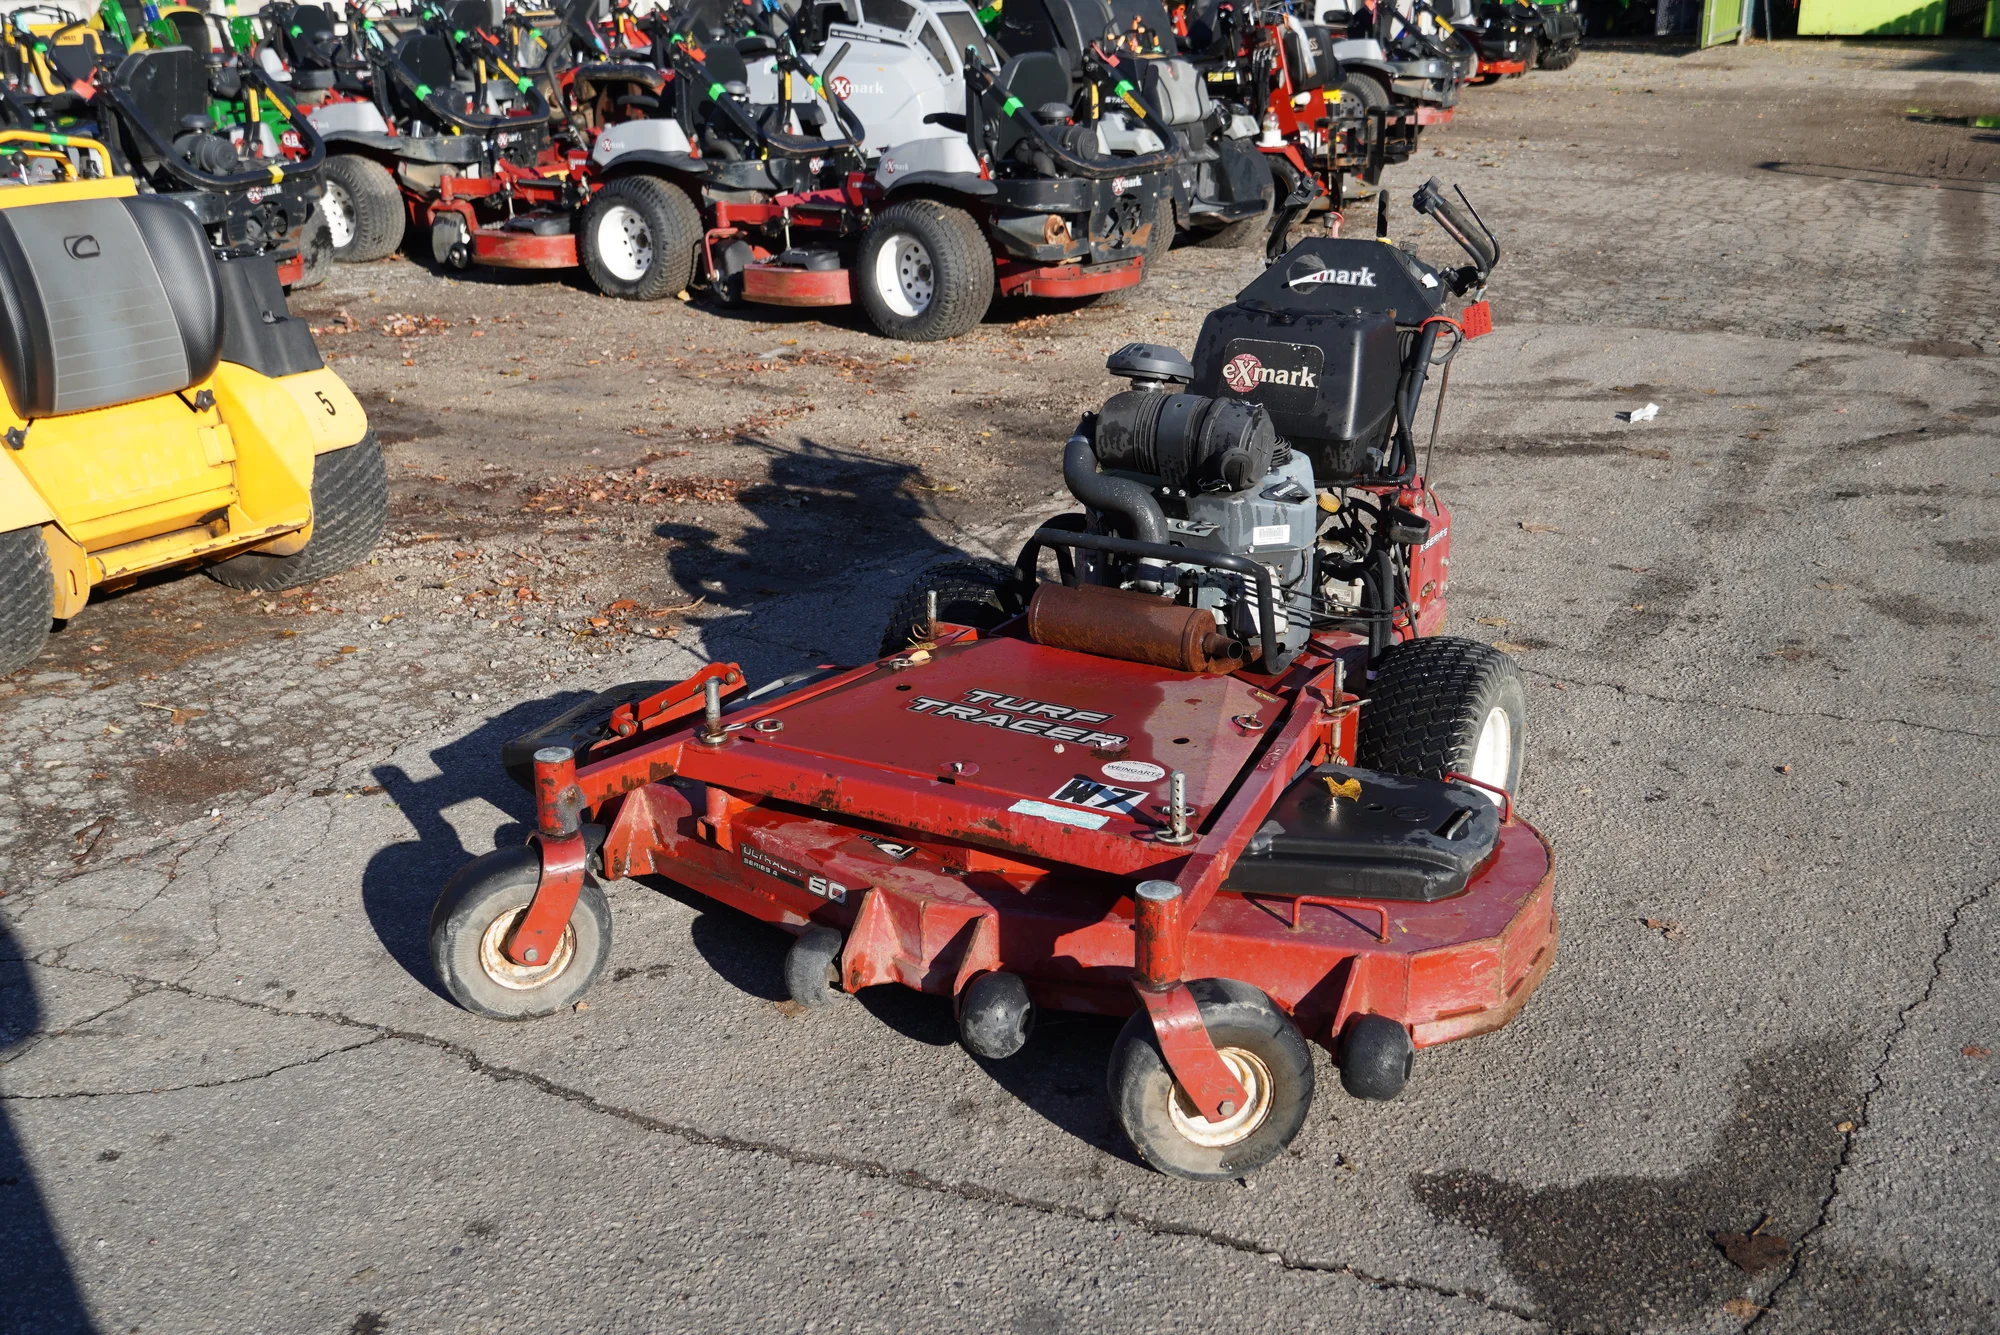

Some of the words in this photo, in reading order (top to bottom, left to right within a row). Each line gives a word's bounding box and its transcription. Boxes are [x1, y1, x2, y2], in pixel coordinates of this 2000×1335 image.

[1113, 177, 1142, 192] eXmark
[1222, 359, 1318, 388] eXmark
[314, 390, 336, 416] 5
[964, 689, 1114, 724] TURF
[908, 697, 1127, 746] TRACER
[1055, 779, 1144, 808] W7
[743, 857, 771, 874] SERIES
[808, 874, 847, 905] 60
